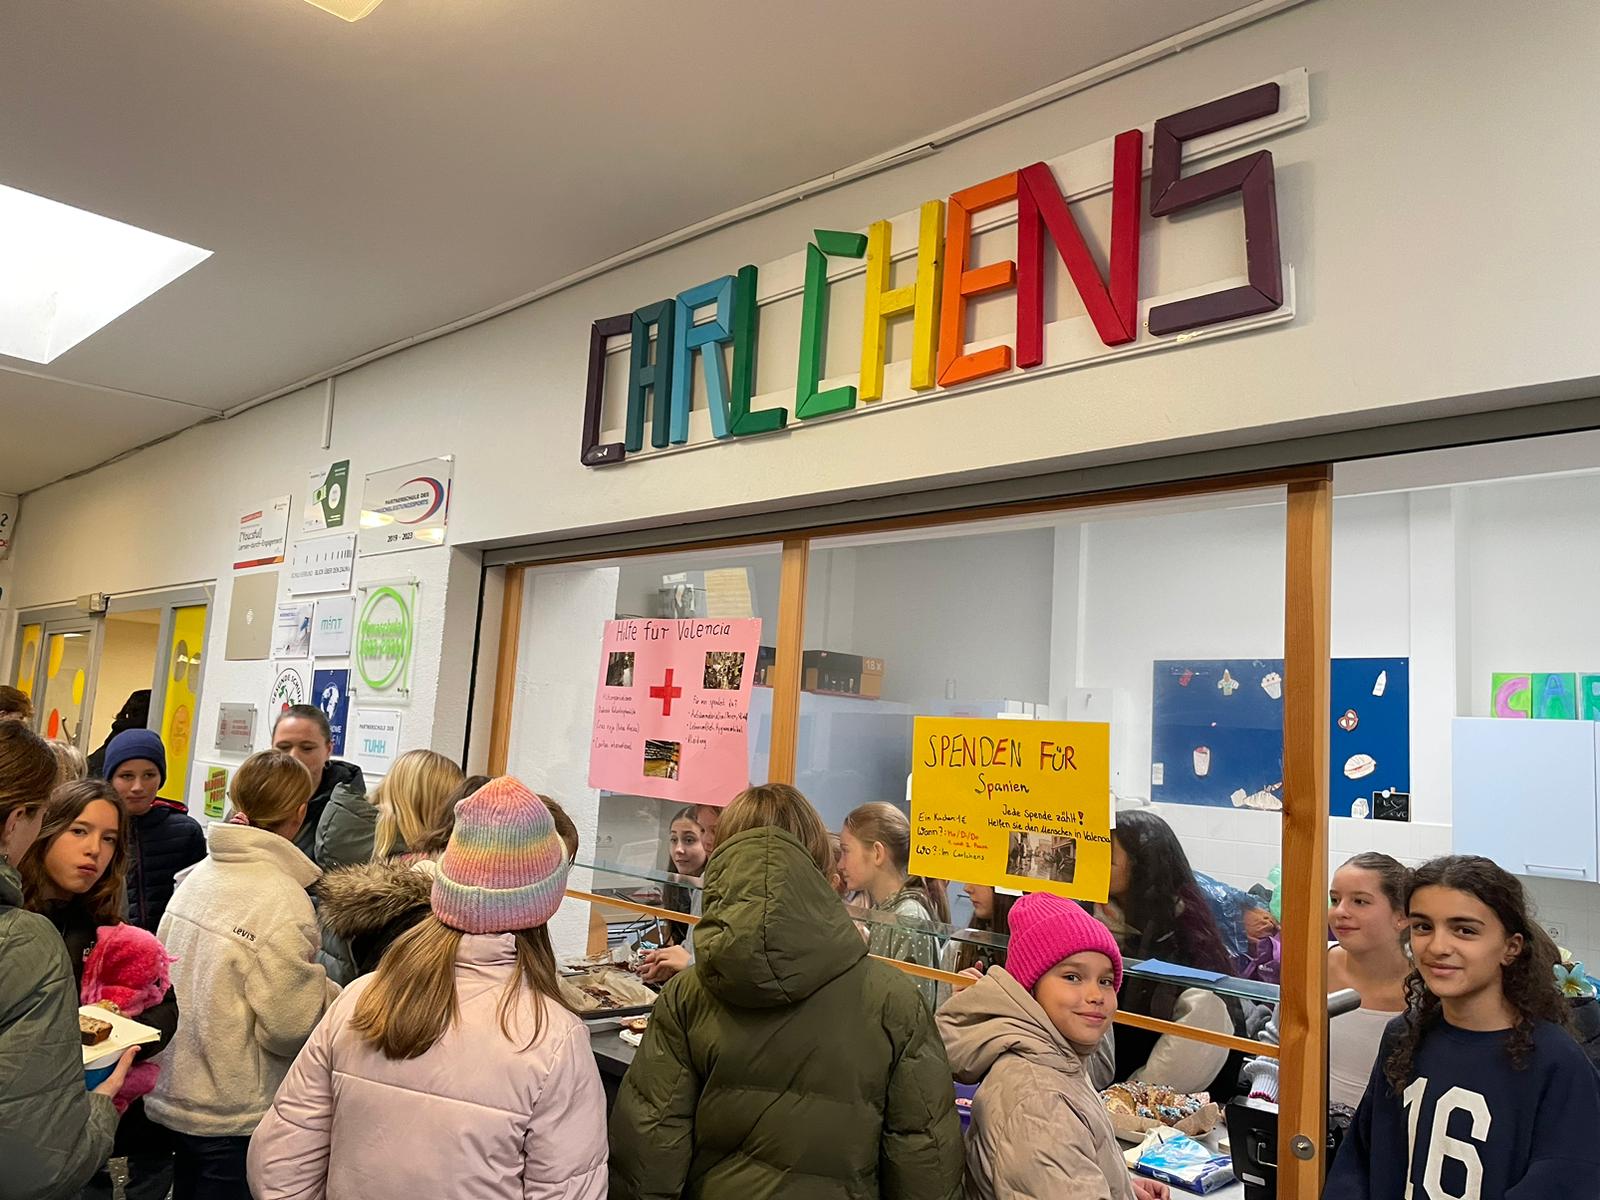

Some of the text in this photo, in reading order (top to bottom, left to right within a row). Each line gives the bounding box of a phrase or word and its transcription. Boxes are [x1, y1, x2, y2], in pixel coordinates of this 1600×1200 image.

[677, 619, 731, 640] Valencia
[364, 739, 386, 754] TUHH
[924, 733, 1077, 771] SPENDEN FÜR
[975, 772, 1029, 800] Spanien
[1002, 803, 1021, 817] Jede
[1024, 809, 1053, 822] Spende
[987, 818, 1011, 829] Helfen
[1024, 824, 1039, 833] den
[1074, 829, 1081, 839] in
[1403, 1077, 1492, 1200] 16
